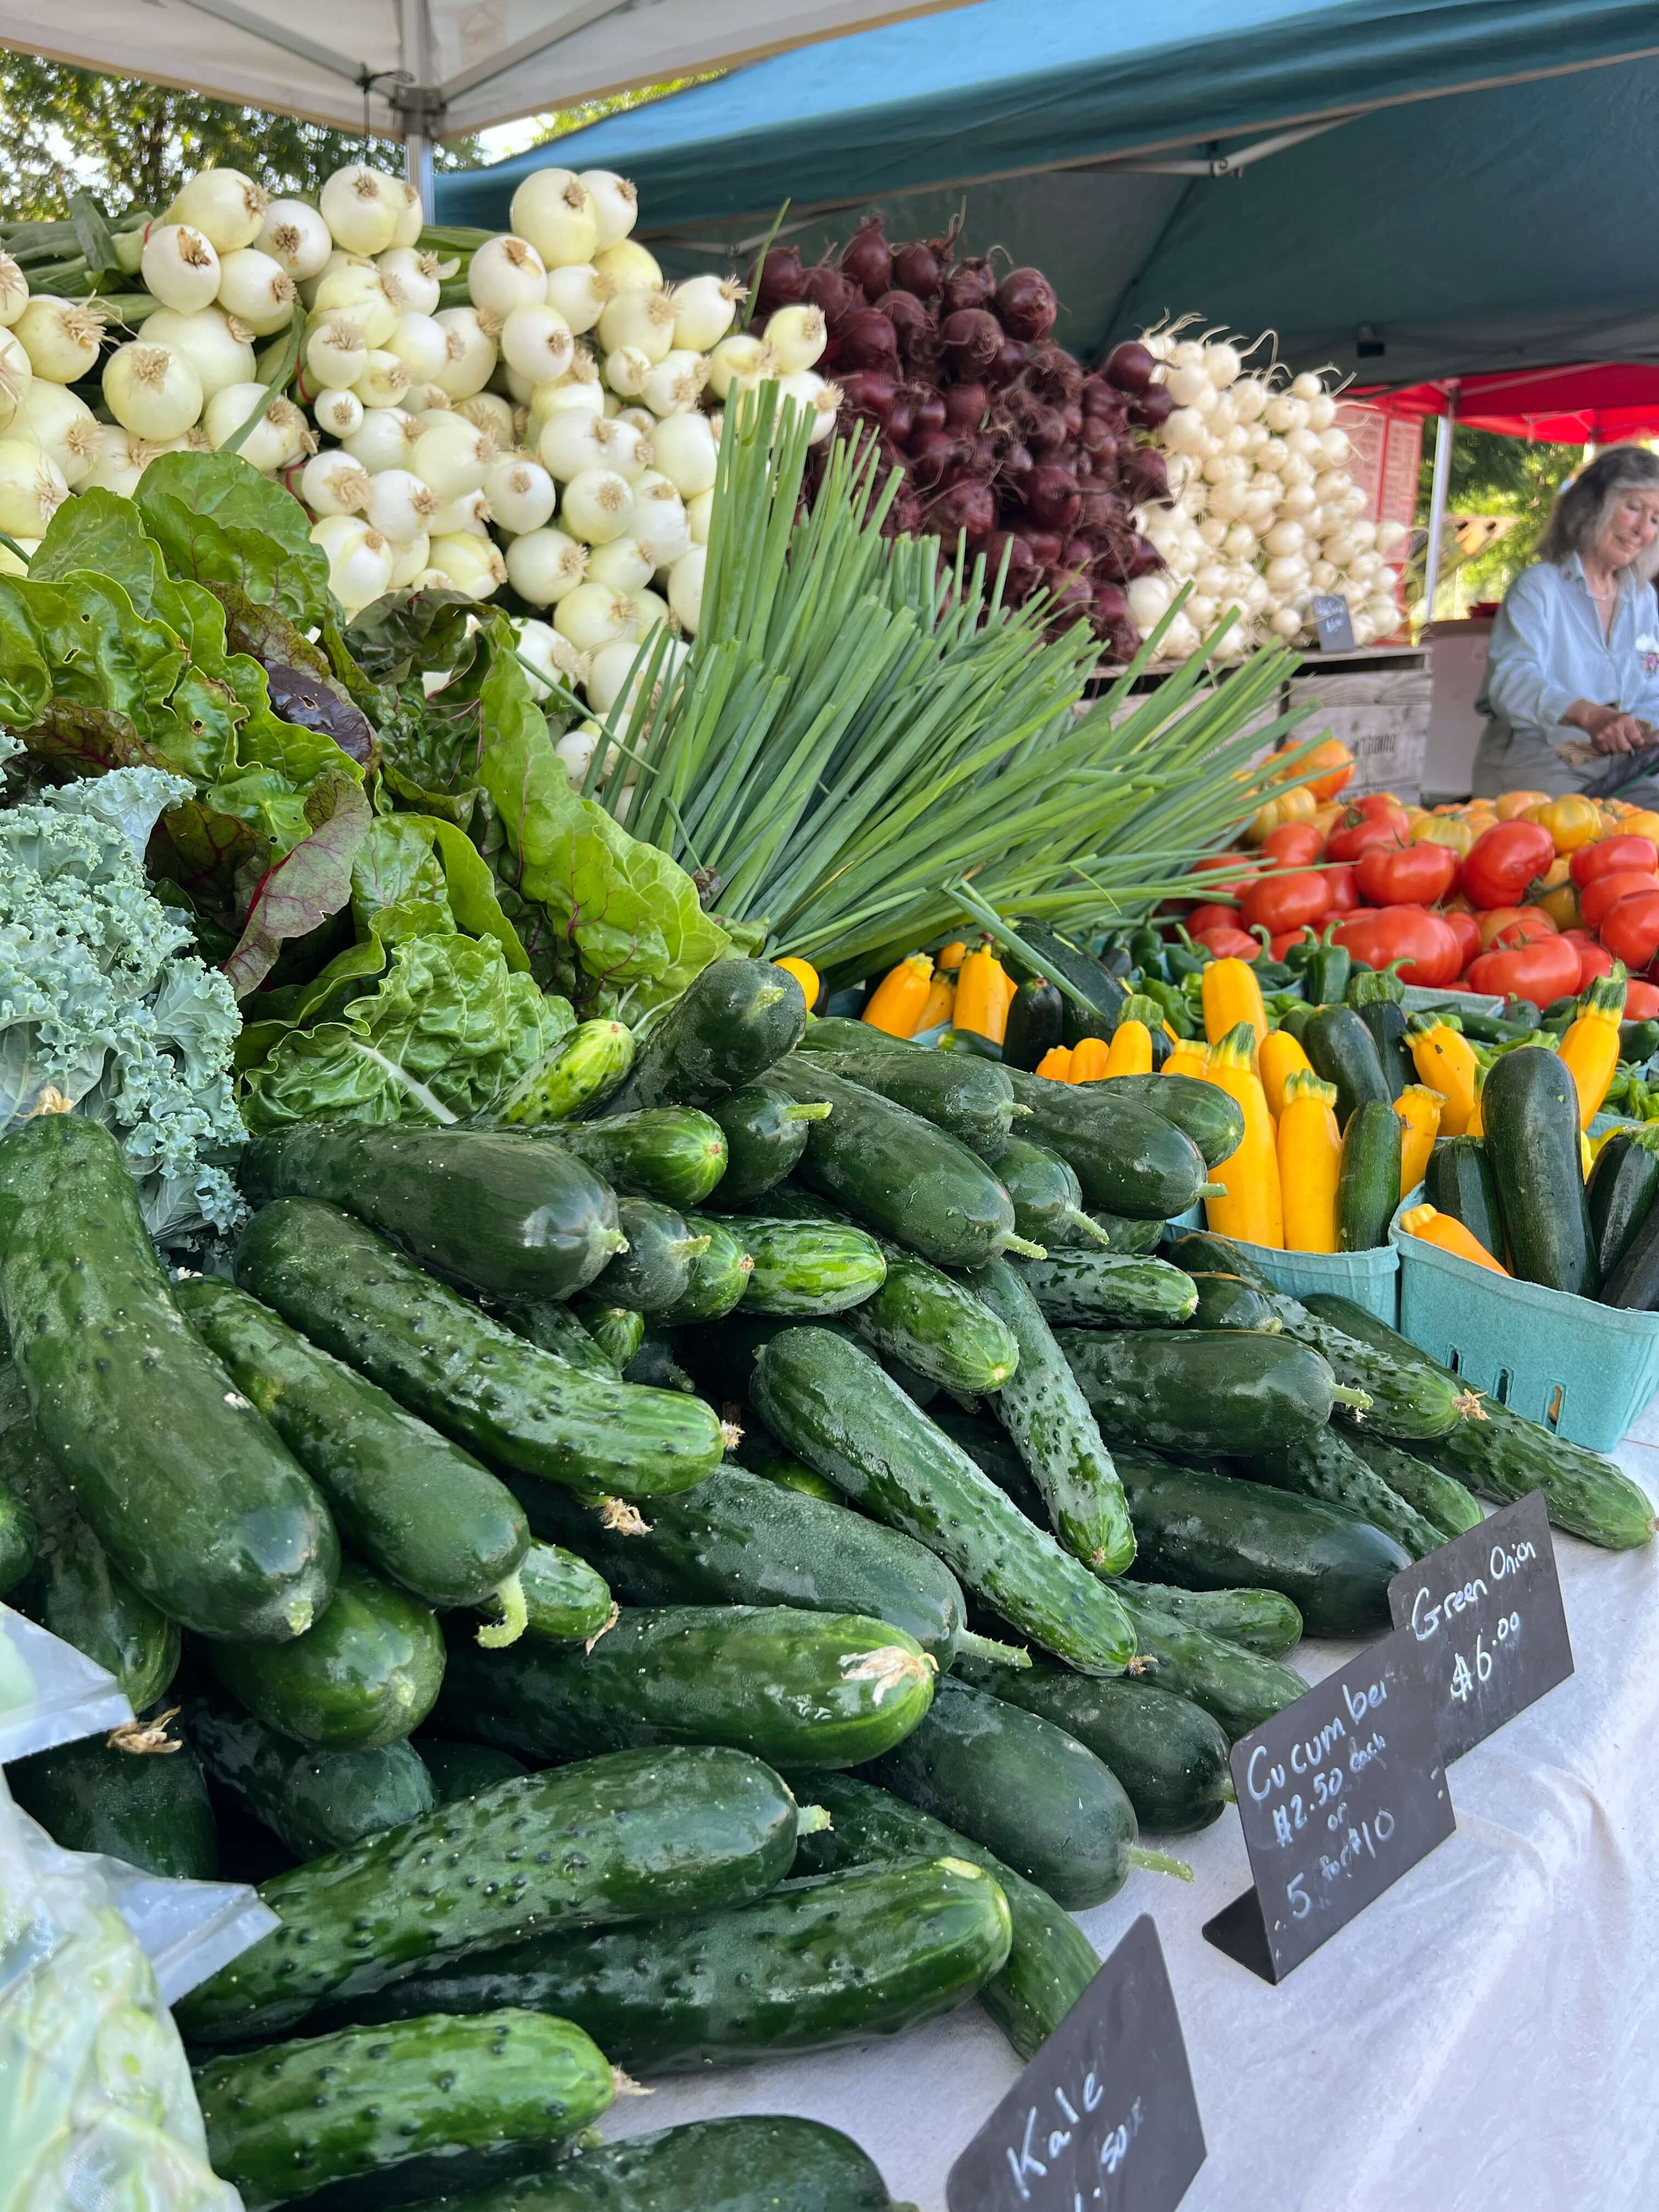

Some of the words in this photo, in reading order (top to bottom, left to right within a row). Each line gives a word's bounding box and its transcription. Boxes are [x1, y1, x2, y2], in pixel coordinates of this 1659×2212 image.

[1412, 1578, 1488, 1641] Green
[1490, 1541, 1536, 1580] Onion
[1450, 1611, 1520, 1702] $6.00
[1272, 1767, 1343, 1848] $2.50
[1327, 1801, 1348, 1831] or
[1286, 1871, 1313, 1919] 5
[1319, 1844, 1350, 1882] for
[1006, 2072, 1104, 2202] Kale
